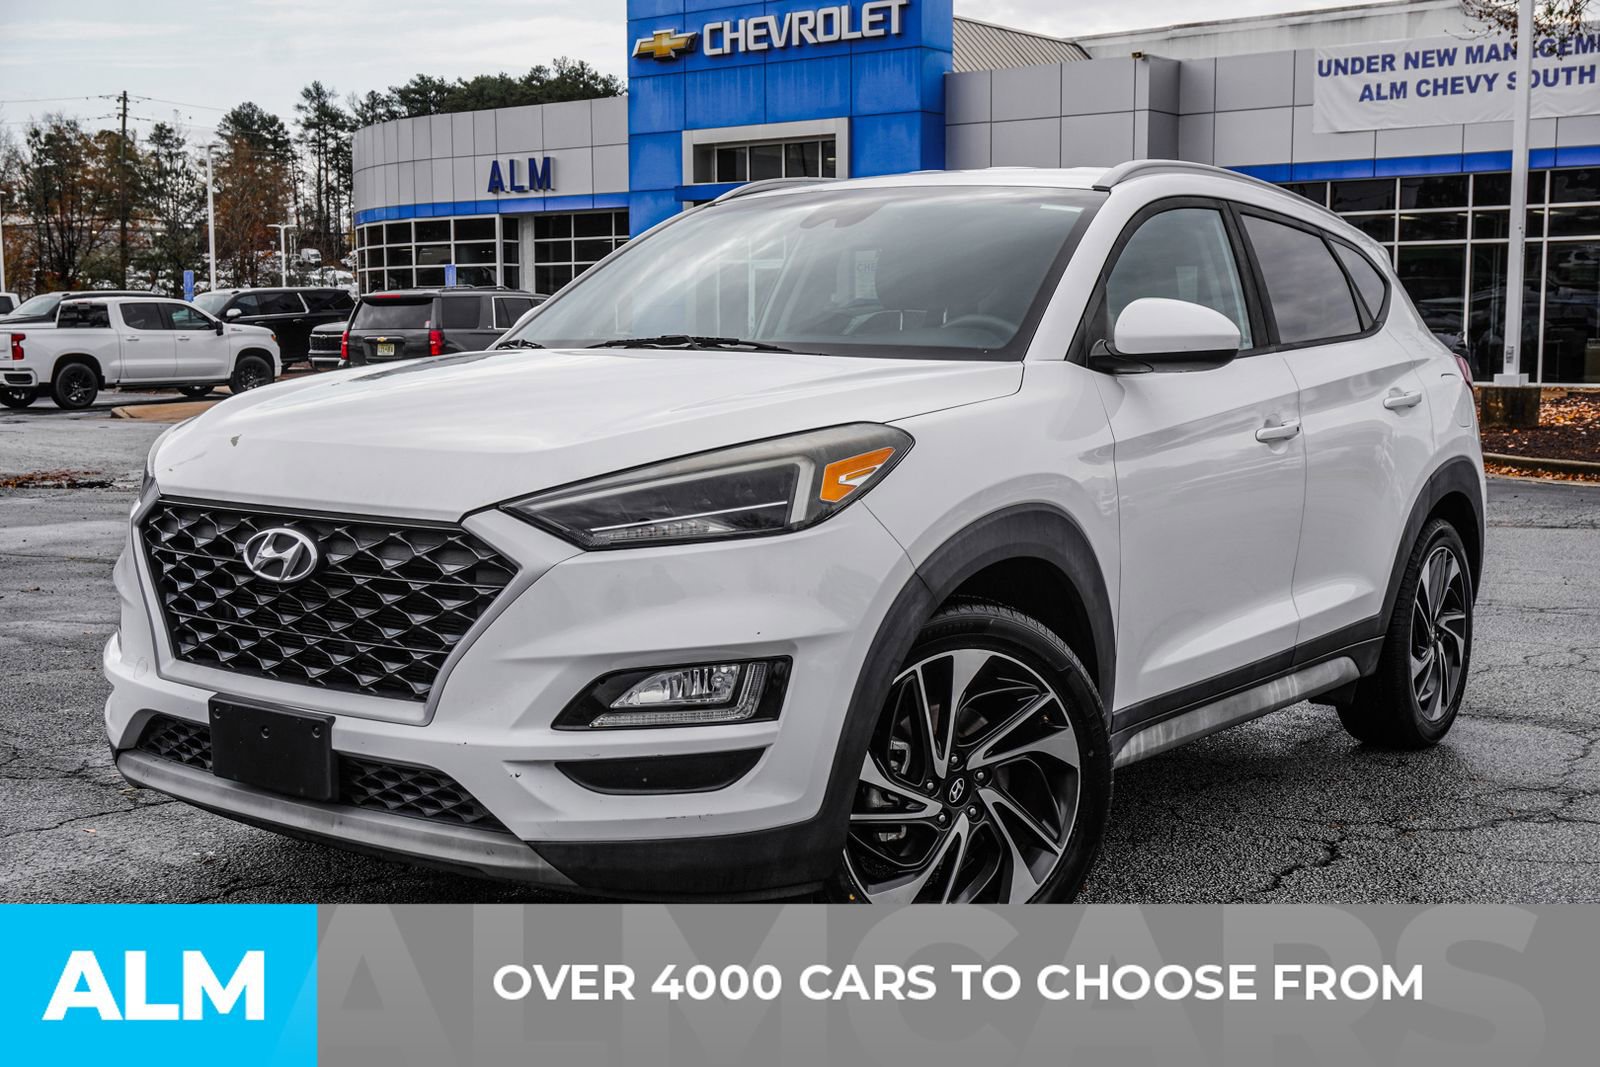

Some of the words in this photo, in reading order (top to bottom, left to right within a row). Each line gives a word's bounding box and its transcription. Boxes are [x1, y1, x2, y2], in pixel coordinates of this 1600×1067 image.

[703, 1, 907, 56] CHEVROLET
[1317, 54, 1396, 77] UNDER
[1403, 48, 1458, 70] NEW
[1466, 33, 1600, 64] MANGEM
[1359, 81, 1408, 102] ALM
[1416, 73, 1499, 98] CHEVY
[487, 156, 552, 193] ALM
